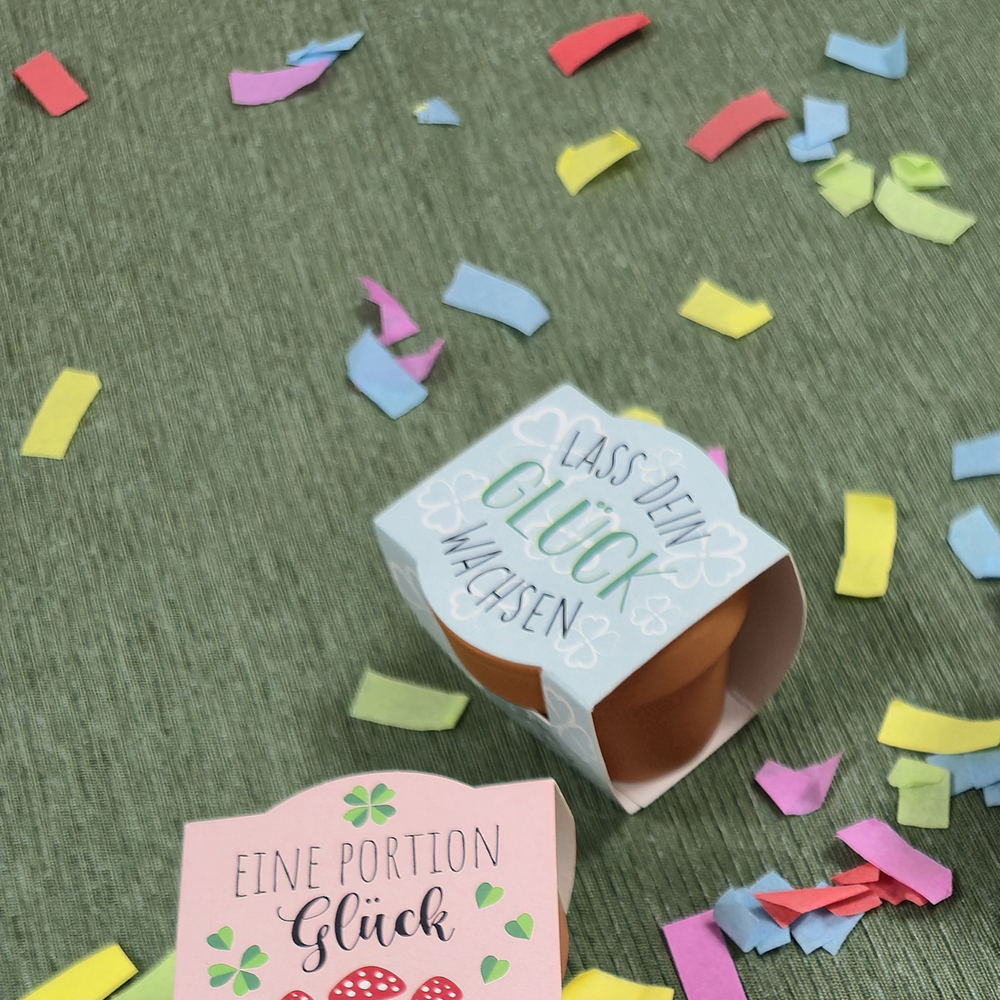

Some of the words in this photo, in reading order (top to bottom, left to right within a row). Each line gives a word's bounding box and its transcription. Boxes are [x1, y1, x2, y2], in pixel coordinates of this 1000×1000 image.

[481, 461, 678, 614] GLÜCK
[560, 430, 647, 486] LASS
[634, 475, 711, 549] DEIN
[441, 522, 583, 639] WACHSEN
[235, 846, 322, 898] EINE
[340, 824, 501, 886] PORTION
[277, 886, 455, 973] Glück
